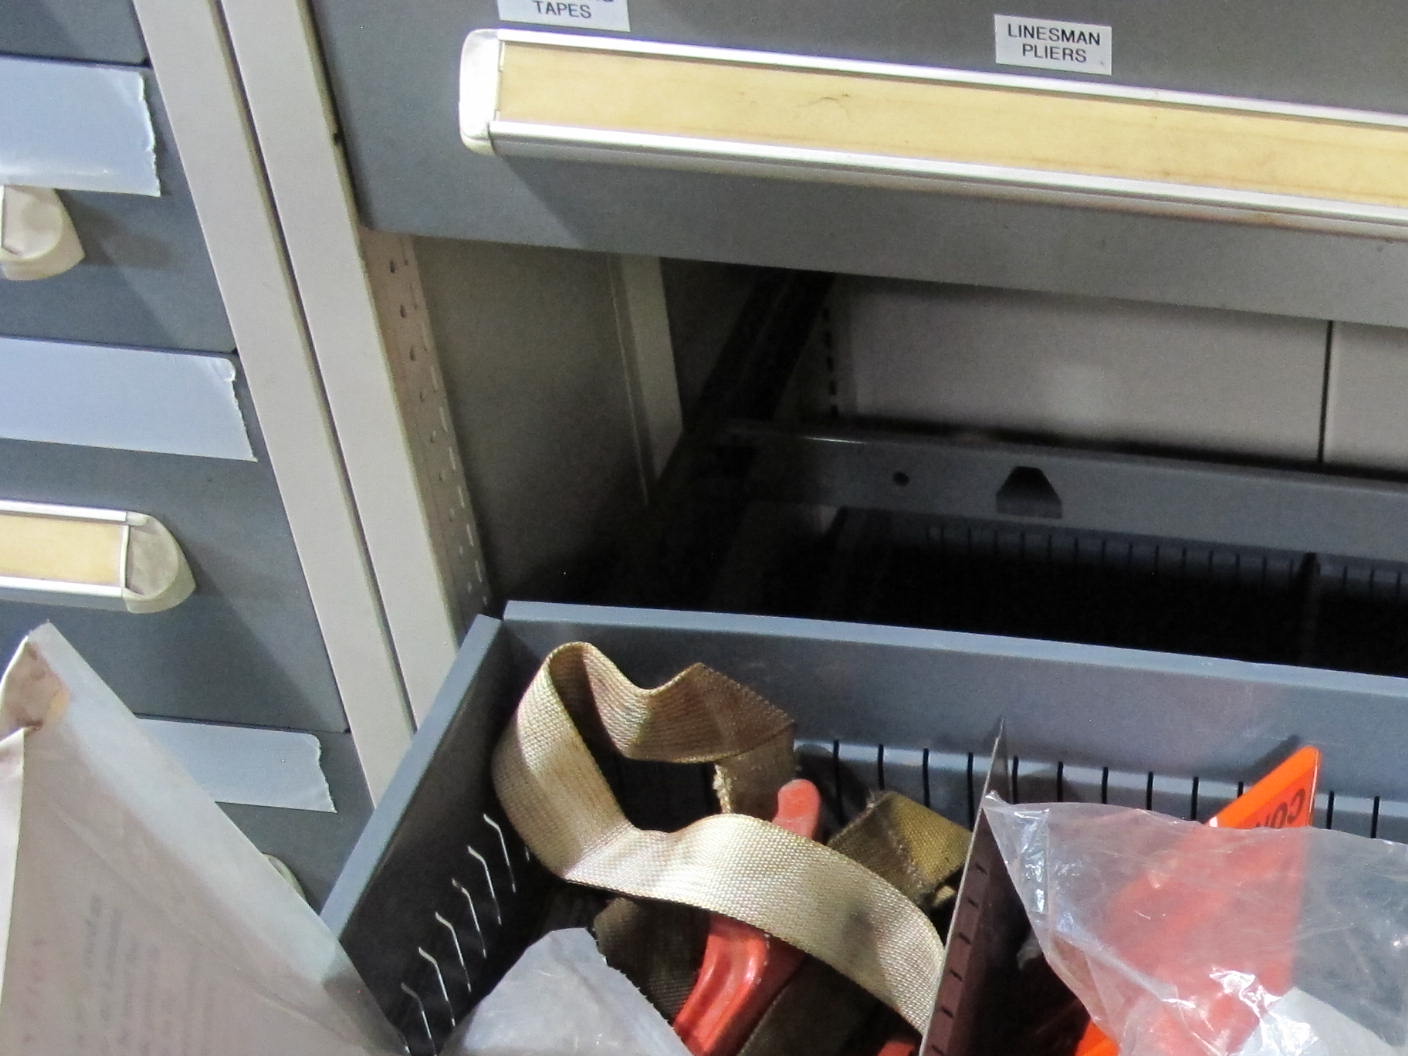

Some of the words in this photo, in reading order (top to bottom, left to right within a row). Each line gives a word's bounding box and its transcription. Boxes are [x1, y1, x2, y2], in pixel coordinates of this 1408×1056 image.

[534, 1, 592, 18] TAPES
[1008, 23, 1100, 46] LINESMAN
[1022, 43, 1087, 64] PLIERS
